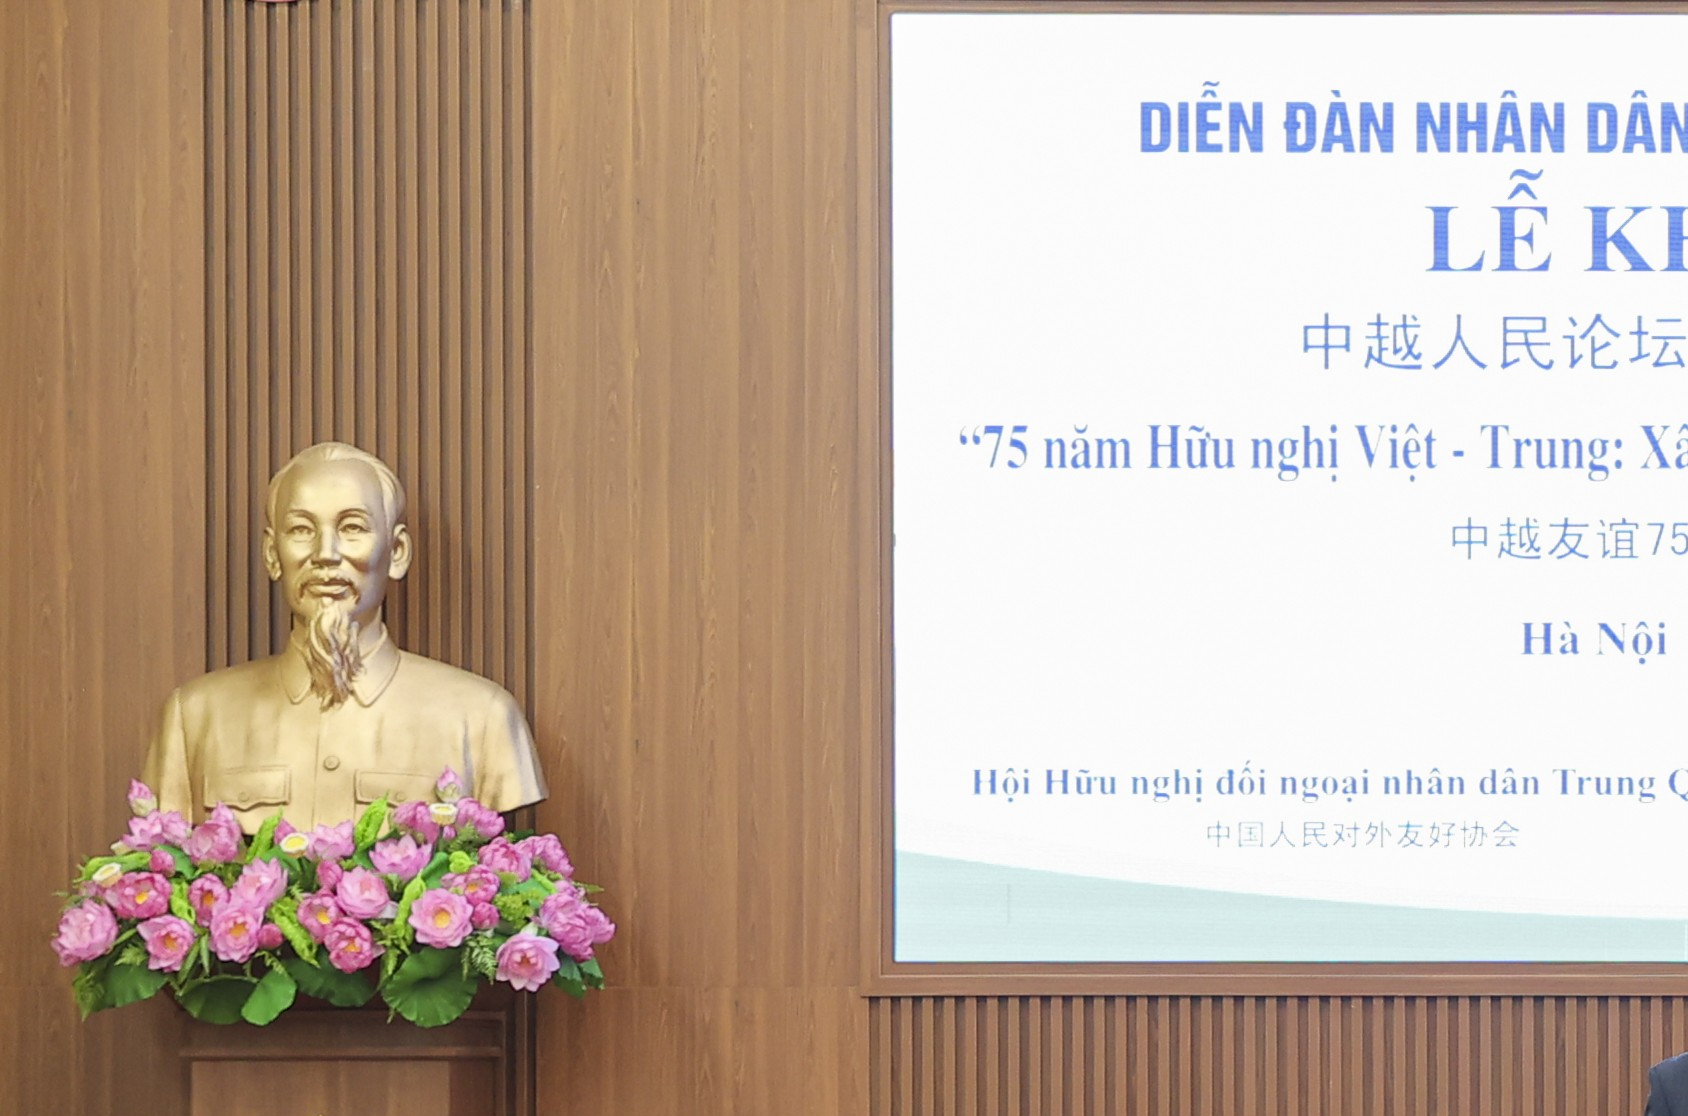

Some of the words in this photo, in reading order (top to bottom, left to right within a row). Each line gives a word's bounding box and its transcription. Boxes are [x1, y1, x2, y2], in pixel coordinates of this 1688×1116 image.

[1139, 80, 1265, 155] DIỄN
[1282, 89, 1395, 155] ĐÀN
[1415, 89, 1566, 155] NHÂN
[1426, 168, 1553, 273] LỄ
[1044, 424, 1132, 470] năm
[1148, 423, 1236, 470] Hữu
[1250, 423, 1340, 483] nghị
[1355, 423, 1438, 482] Việt
[1452, 449, 1465, 458] -
[1480, 424, 1624, 482] Trung:
[1521, 621, 1581, 657] Hà
[1596, 620, 1668, 666] Nội
[972, 767, 1031, 804] Hội
[1044, 767, 1118, 796] Hữu
[1130, 767, 1205, 804] nghị
[1215, 759, 1268, 797] đối
[1279, 767, 1370, 804] ngoại
[1382, 767, 1466, 797] nhân
[1478, 767, 1541, 797] dân
[1551, 767, 1657, 804] Trung
[1205, 819, 1522, 850] 中国人民对外友好协会
